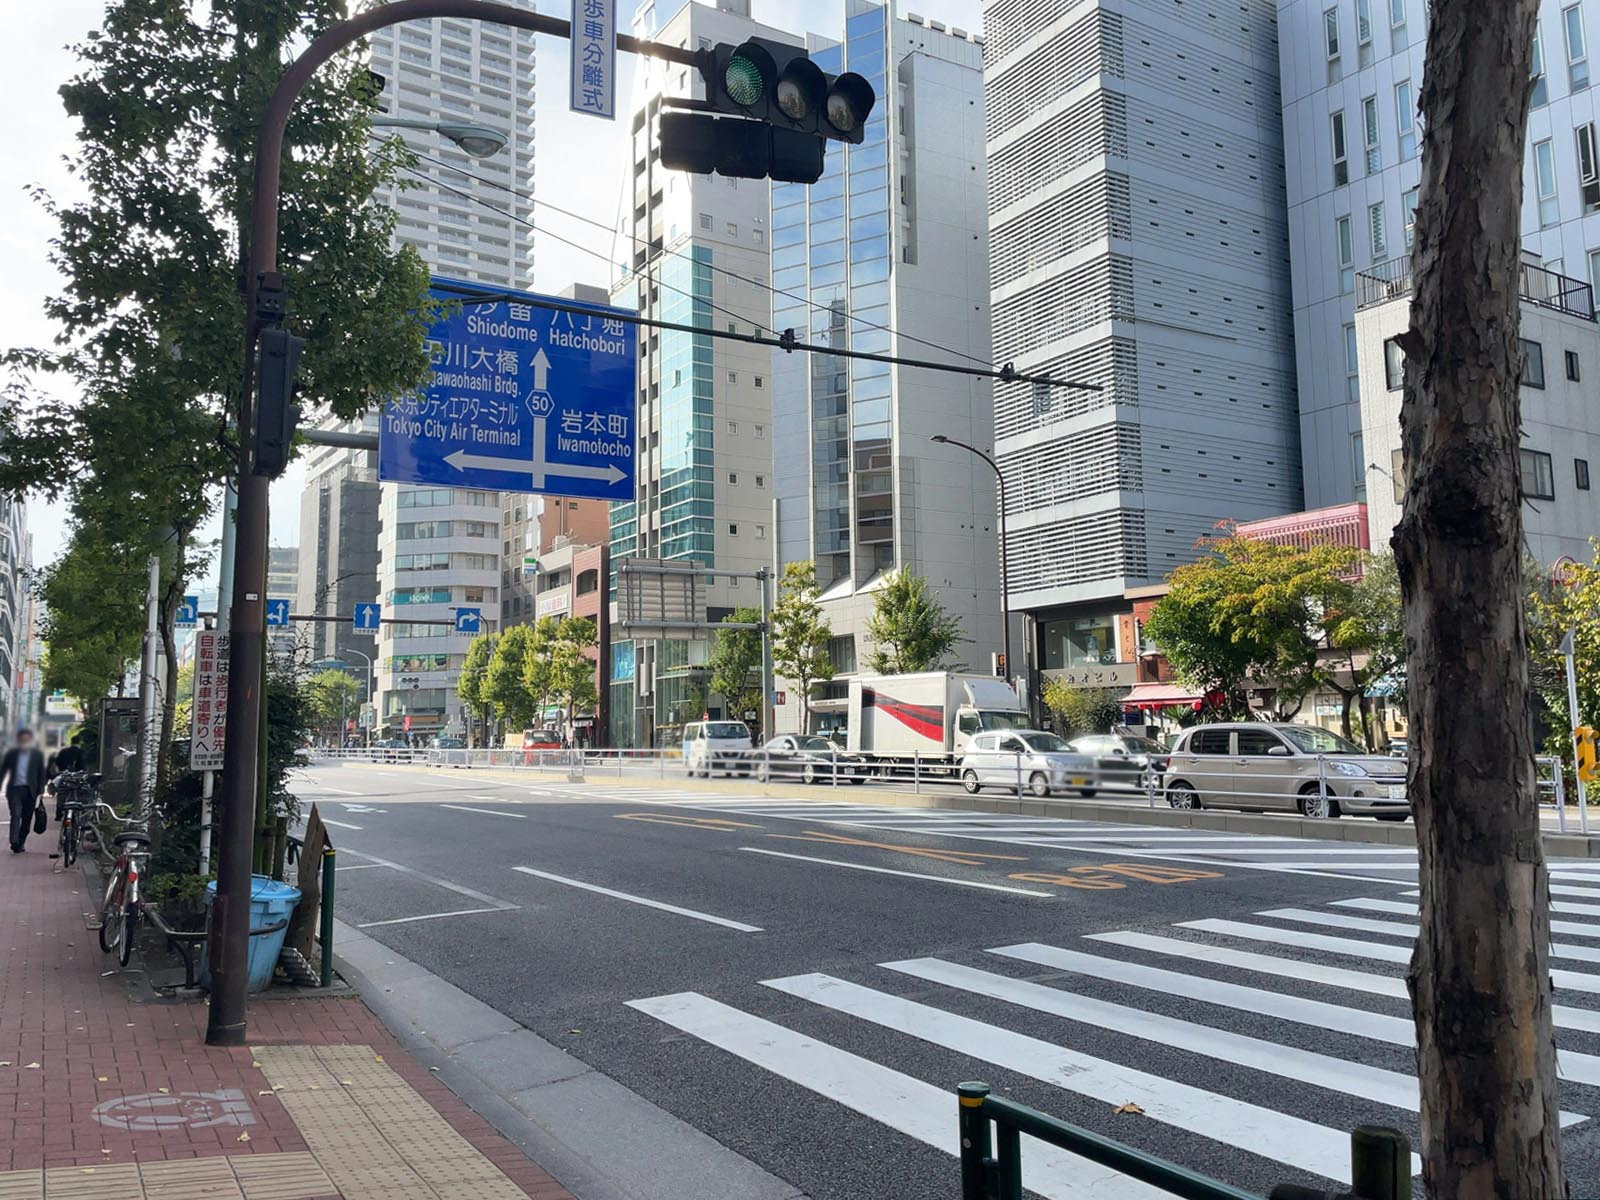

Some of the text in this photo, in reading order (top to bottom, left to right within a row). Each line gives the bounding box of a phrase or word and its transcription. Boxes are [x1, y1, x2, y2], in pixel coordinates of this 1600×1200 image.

[583, 0, 604, 110] 歩車分離式
[467, 315, 538, 342] Shiodome
[550, 328, 625, 355] Hatchobori
[430, 371, 522, 398] gawaohashi Brdg.
[531, 396, 549, 412] 50
[386, 414, 521, 446] Tokyo City Air Terminal
[561, 408, 629, 438] 岩本町
[557, 433, 632, 458] Iwamotocho
